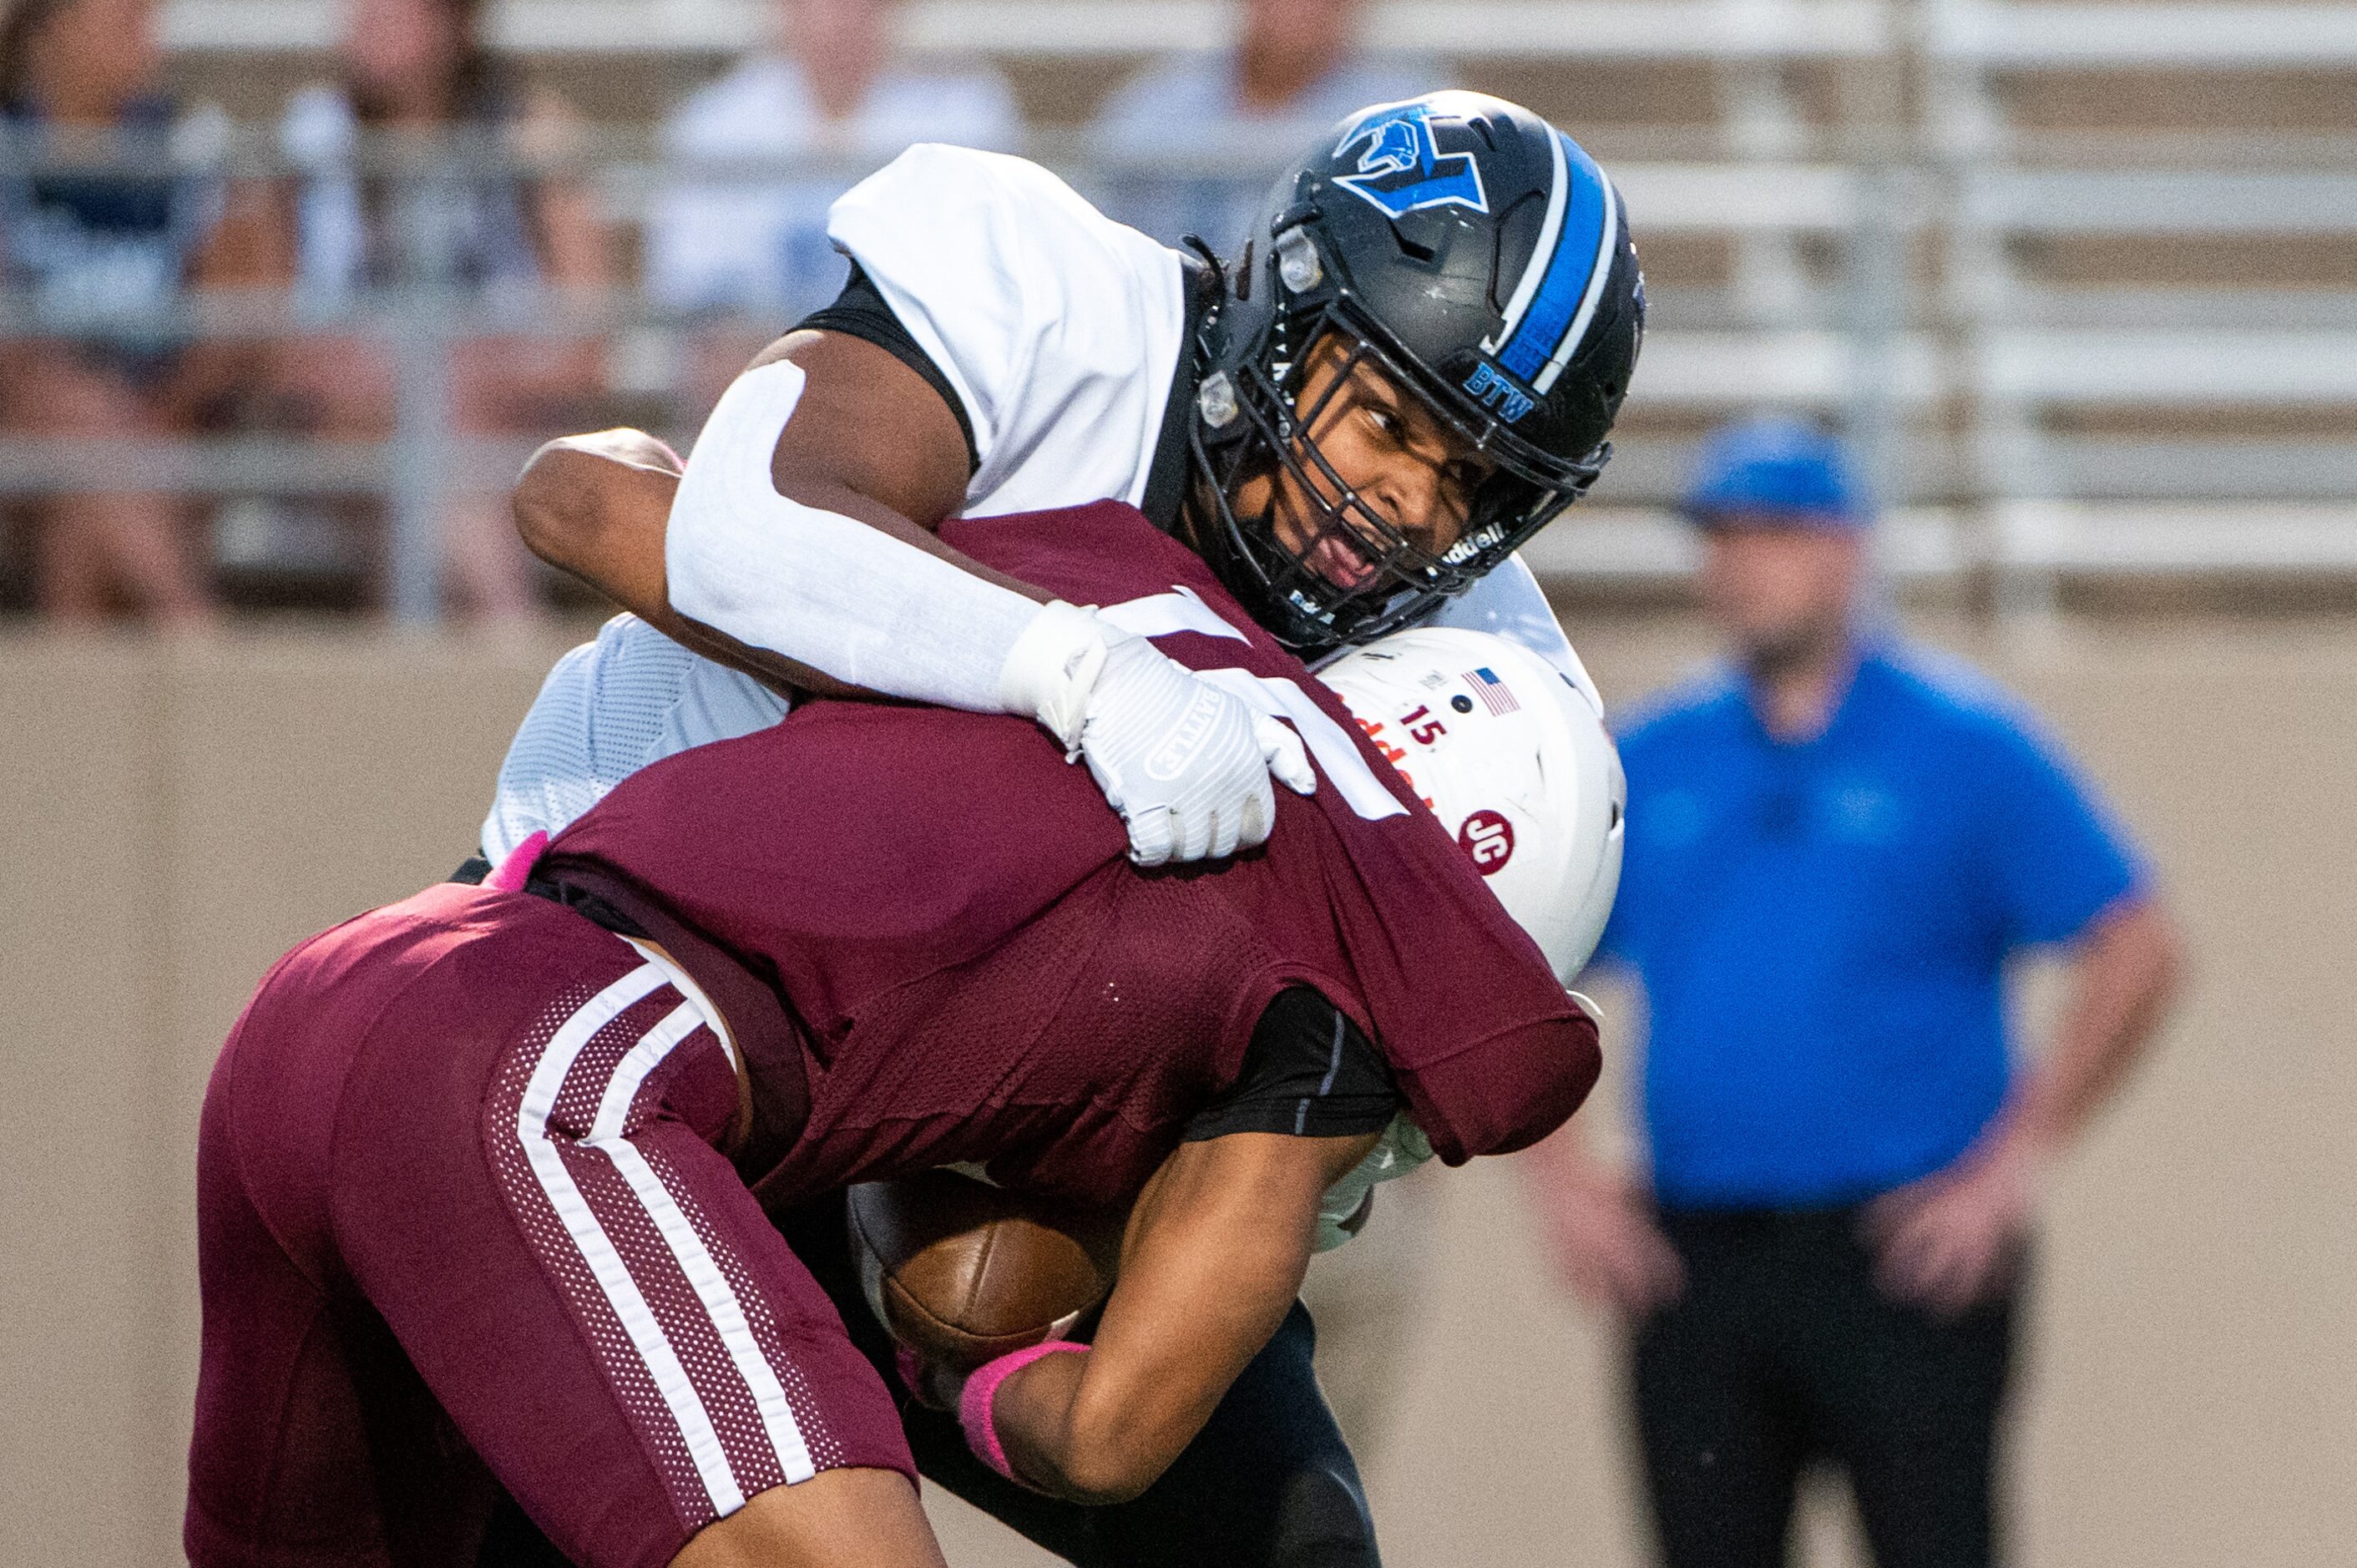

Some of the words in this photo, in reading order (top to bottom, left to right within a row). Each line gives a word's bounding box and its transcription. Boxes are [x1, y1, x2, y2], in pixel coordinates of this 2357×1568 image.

[1463, 362, 1535, 423] BTW
[1426, 522, 1505, 581] ddell
[1155, 685, 1221, 771] BATTLE
[1399, 705, 1447, 745] 15
[1466, 819, 1509, 863] JC
